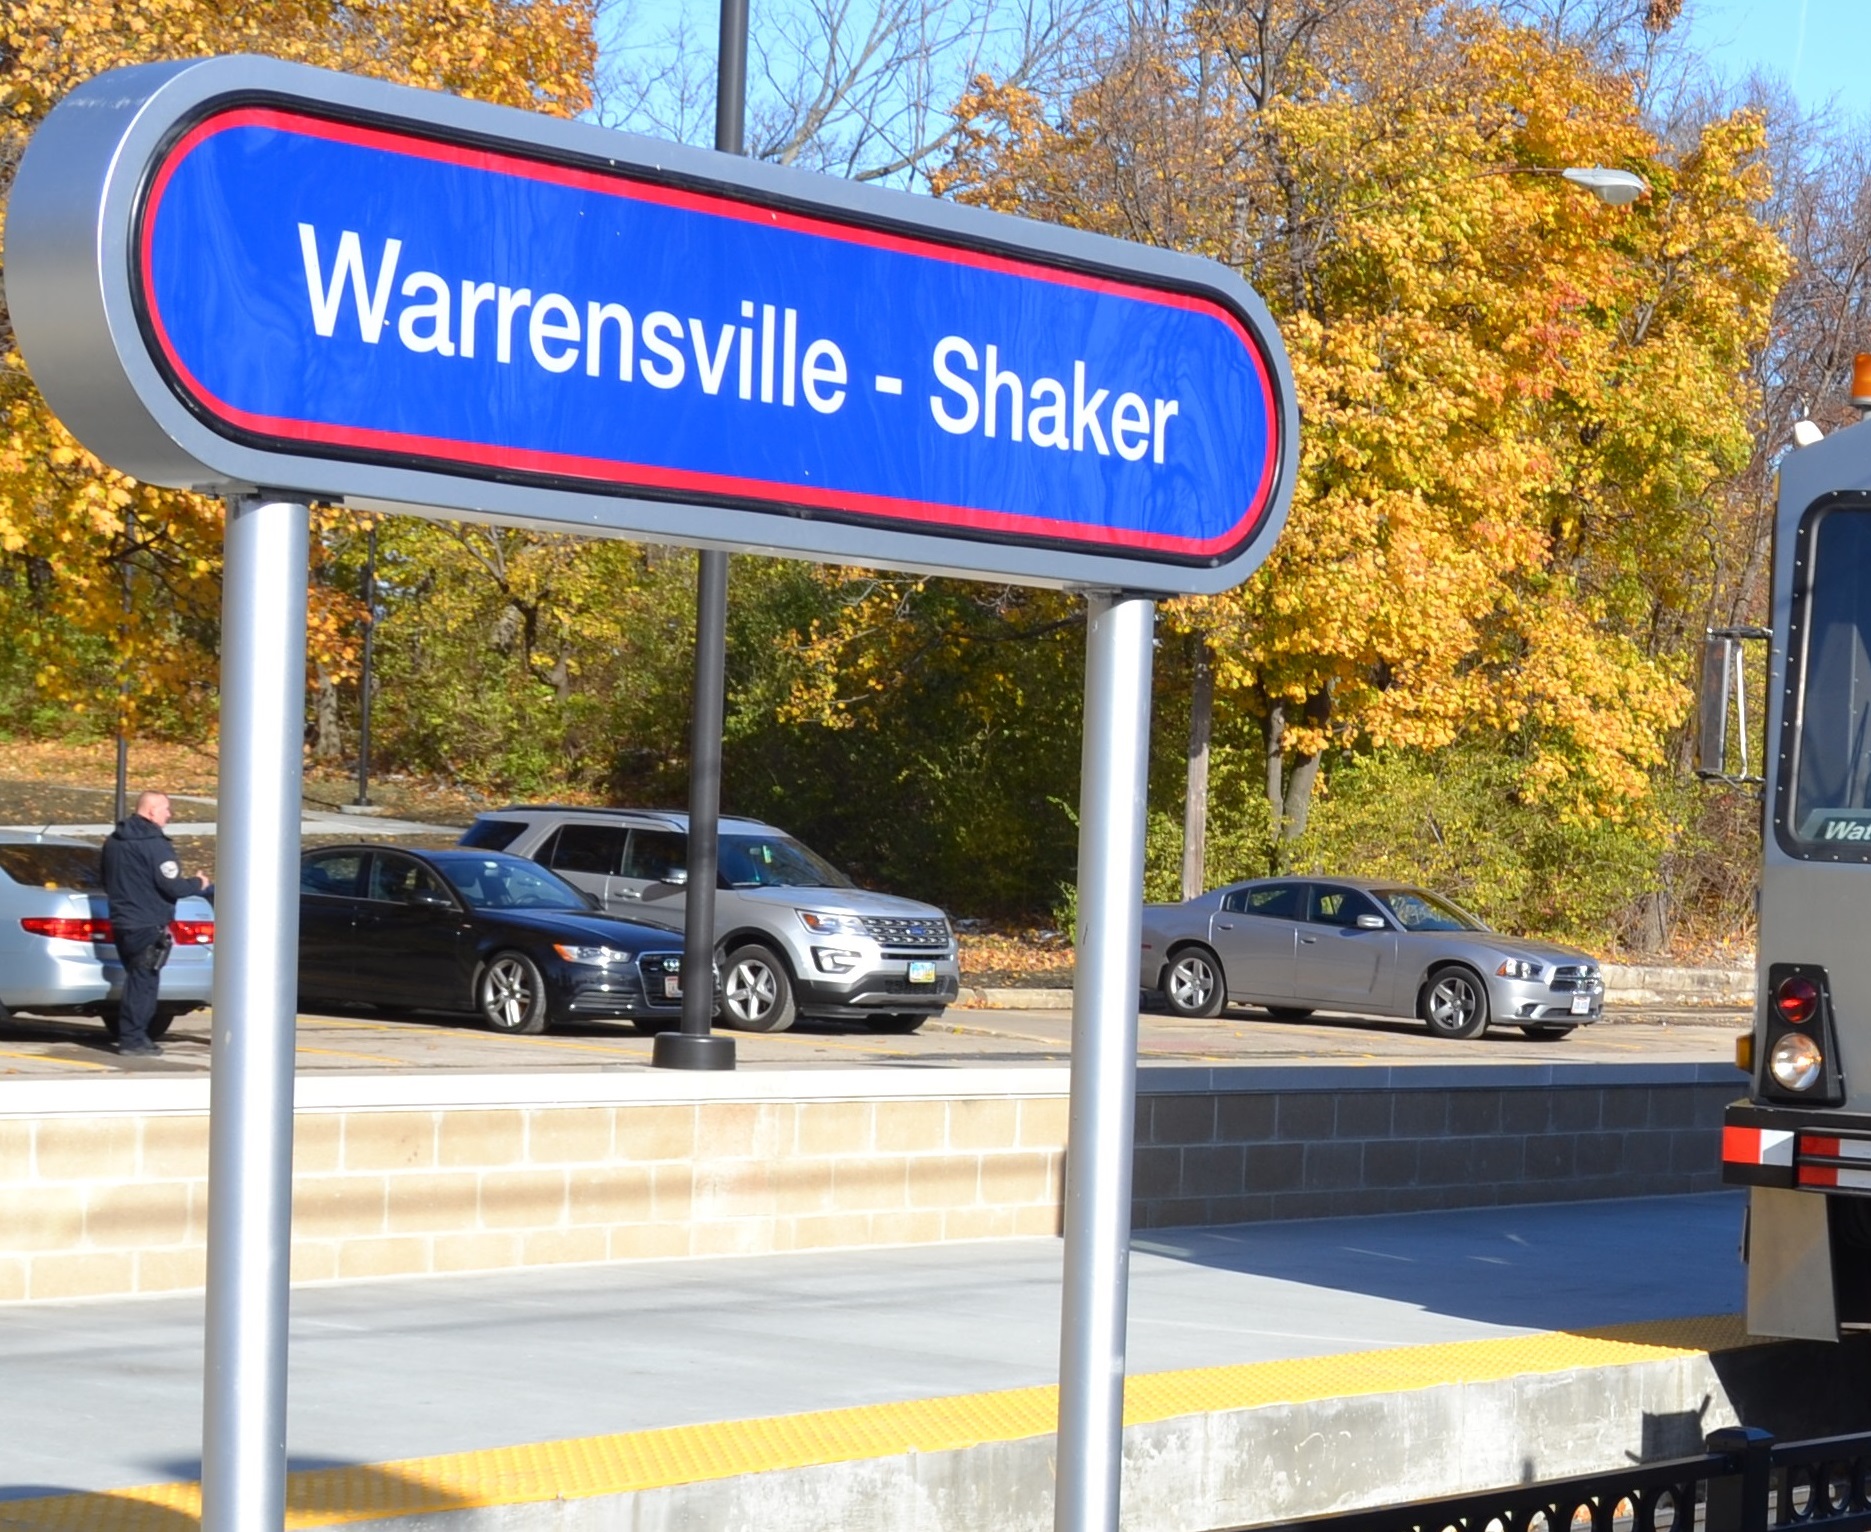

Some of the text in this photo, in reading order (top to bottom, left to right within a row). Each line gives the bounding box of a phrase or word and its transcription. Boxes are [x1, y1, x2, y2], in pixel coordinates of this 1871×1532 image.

[298, 222, 1178, 464] Warrensville - Shaker
